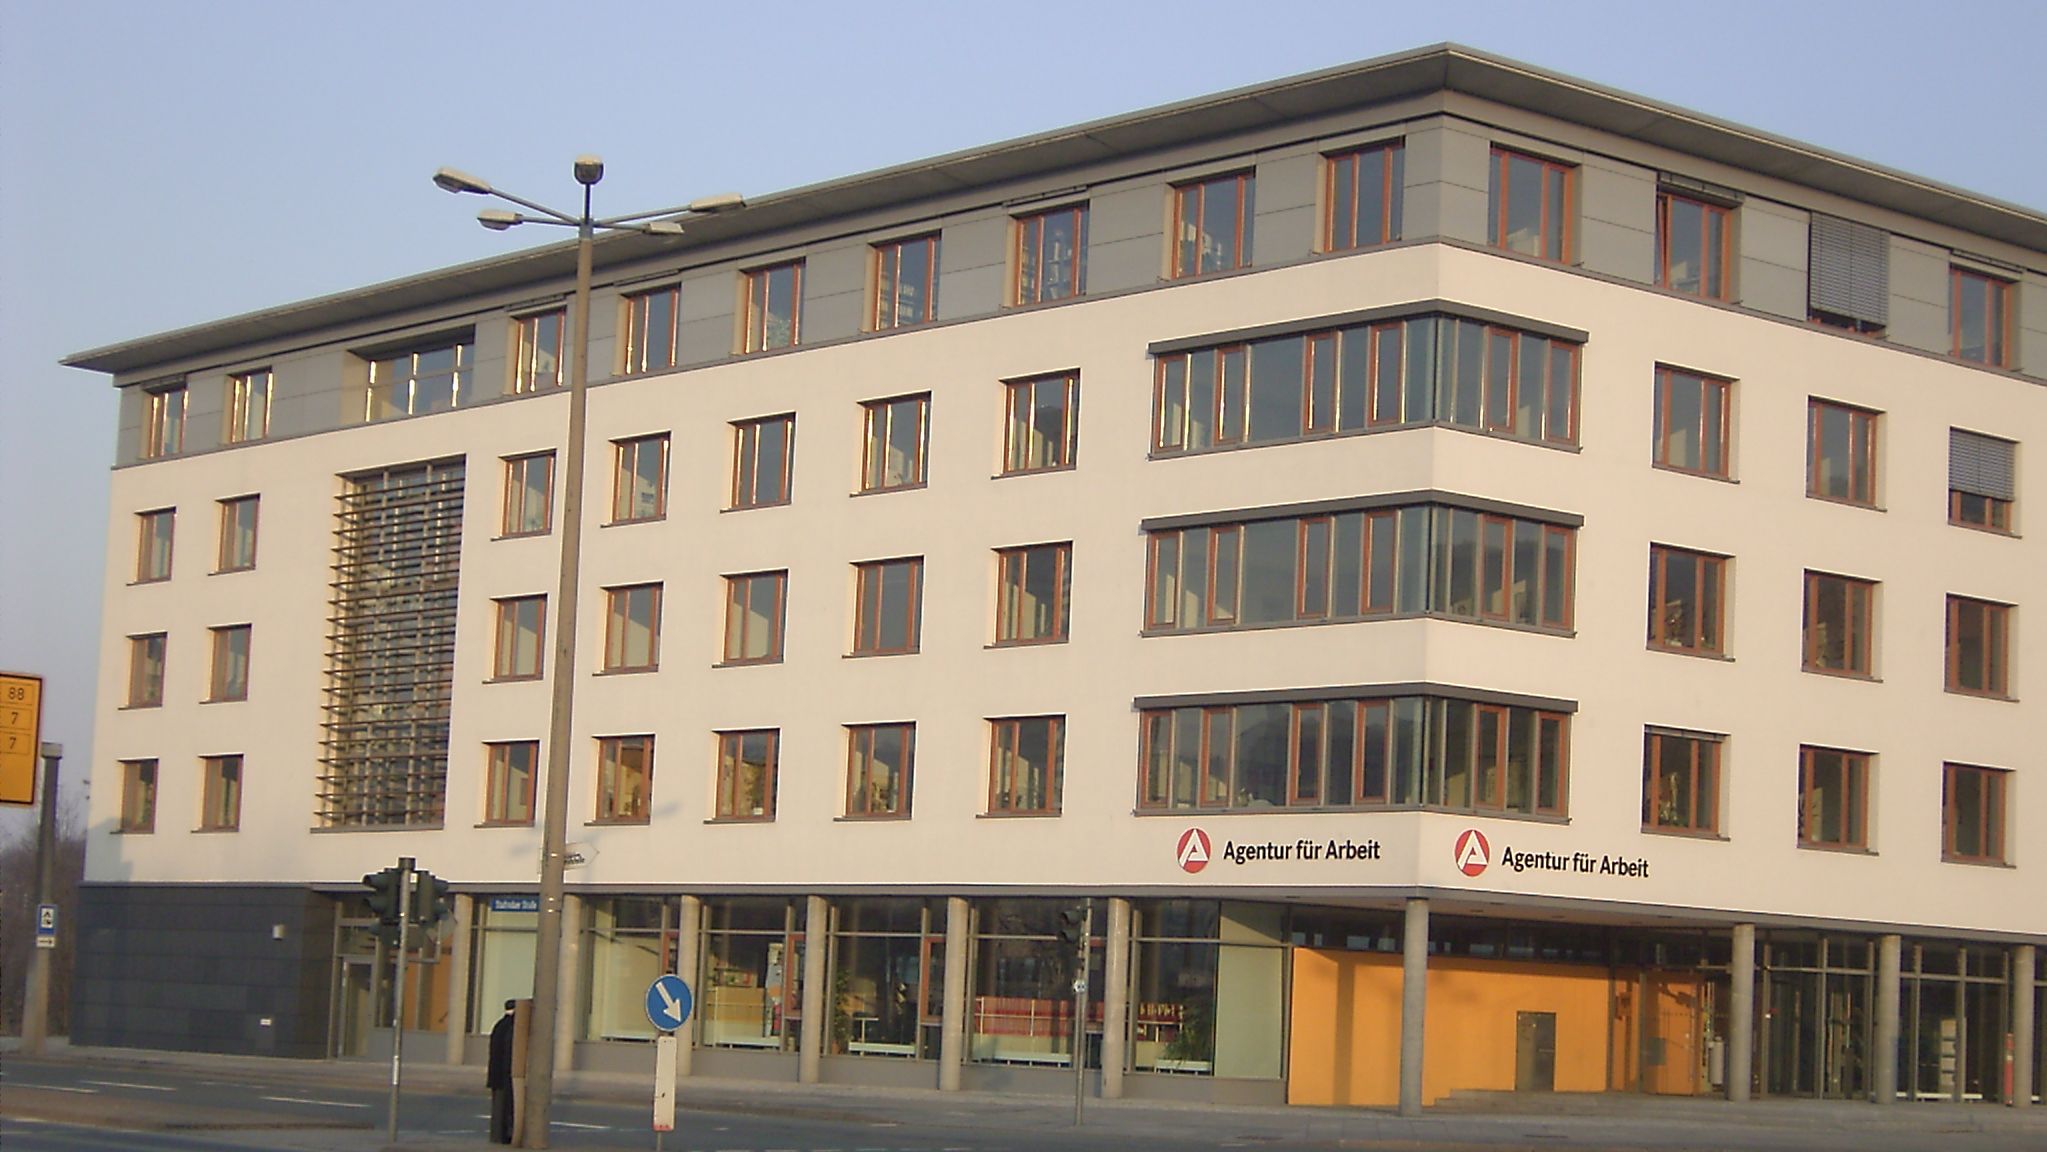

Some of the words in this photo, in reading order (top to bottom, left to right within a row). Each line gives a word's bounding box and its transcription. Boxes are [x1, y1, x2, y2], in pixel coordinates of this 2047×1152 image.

[8, 687, 25, 701] 88
[11, 711, 19, 725] 7
[9, 737, 17, 750] 7
[1223, 840, 1292, 865] Agentur
[1295, 839, 1323, 860] für
[1325, 839, 1381, 860] Arbeit
[1501, 846, 1570, 872] Agentur
[1572, 852, 1597, 873] für
[1599, 855, 1649, 878] Arbeit
